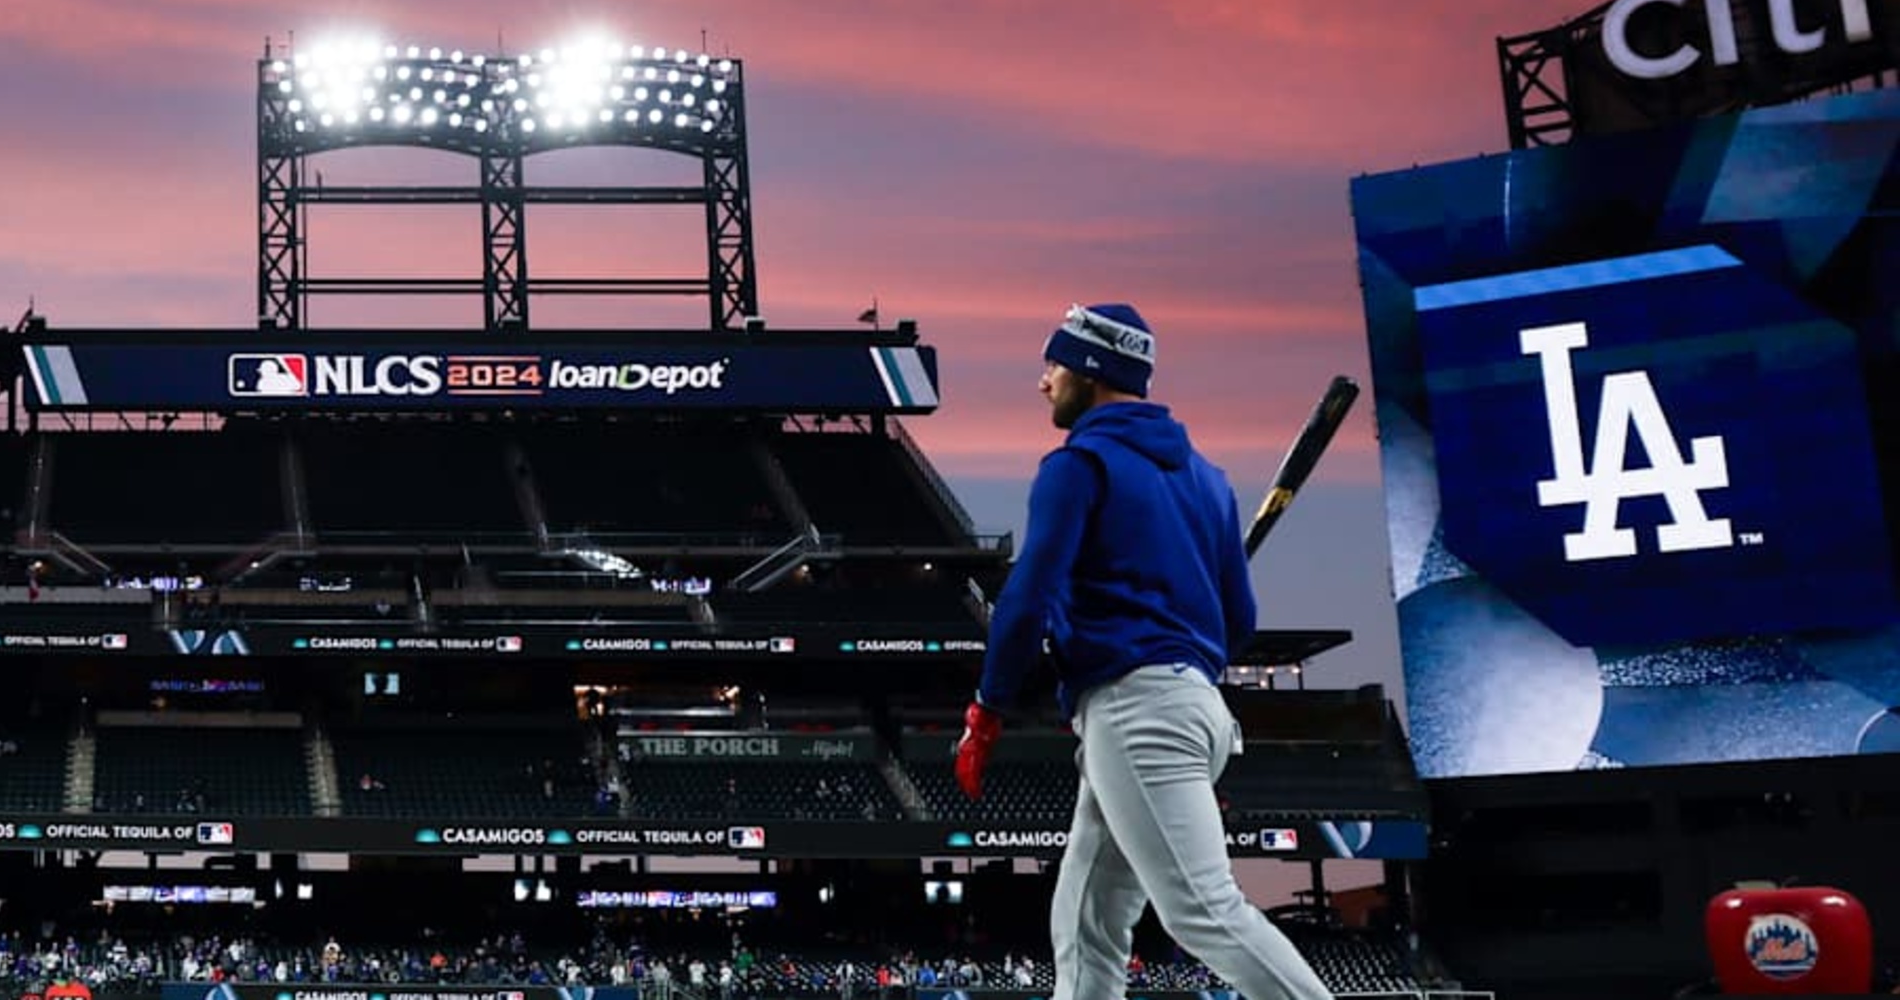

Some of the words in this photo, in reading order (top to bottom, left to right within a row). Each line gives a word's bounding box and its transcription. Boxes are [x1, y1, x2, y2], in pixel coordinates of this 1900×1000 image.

[313, 354, 442, 396] NLCS
[447, 364, 542, 386] 2024
[548, 359, 725, 394] loanDepot
[1518, 321, 1733, 561] LA
[4, 635, 45, 645] OFFICIAL
[309, 637, 377, 650] CASAMIGOS
[396, 638, 439, 649] OFFICIAL
[583, 638, 650, 651] CASAMIGOS
[670, 640, 713, 650] OFFICIAL
[856, 640, 924, 652] CASAMIGOS
[639, 738, 687, 756] THE
[693, 738, 780, 756] PORCH
[46, 824, 109, 839] OFFICIAL
[113, 825, 171, 840] TEQUILA
[174, 826, 194, 840] OF
[443, 828, 545, 844] CASAMIGOS
[576, 830, 639, 844] OFFICIAL
[644, 830, 702, 844] TEQUILA
[705, 830, 725, 844] OF
[974, 831, 1071, 847] CASAMIGO
[1237, 832, 1258, 845] OF
